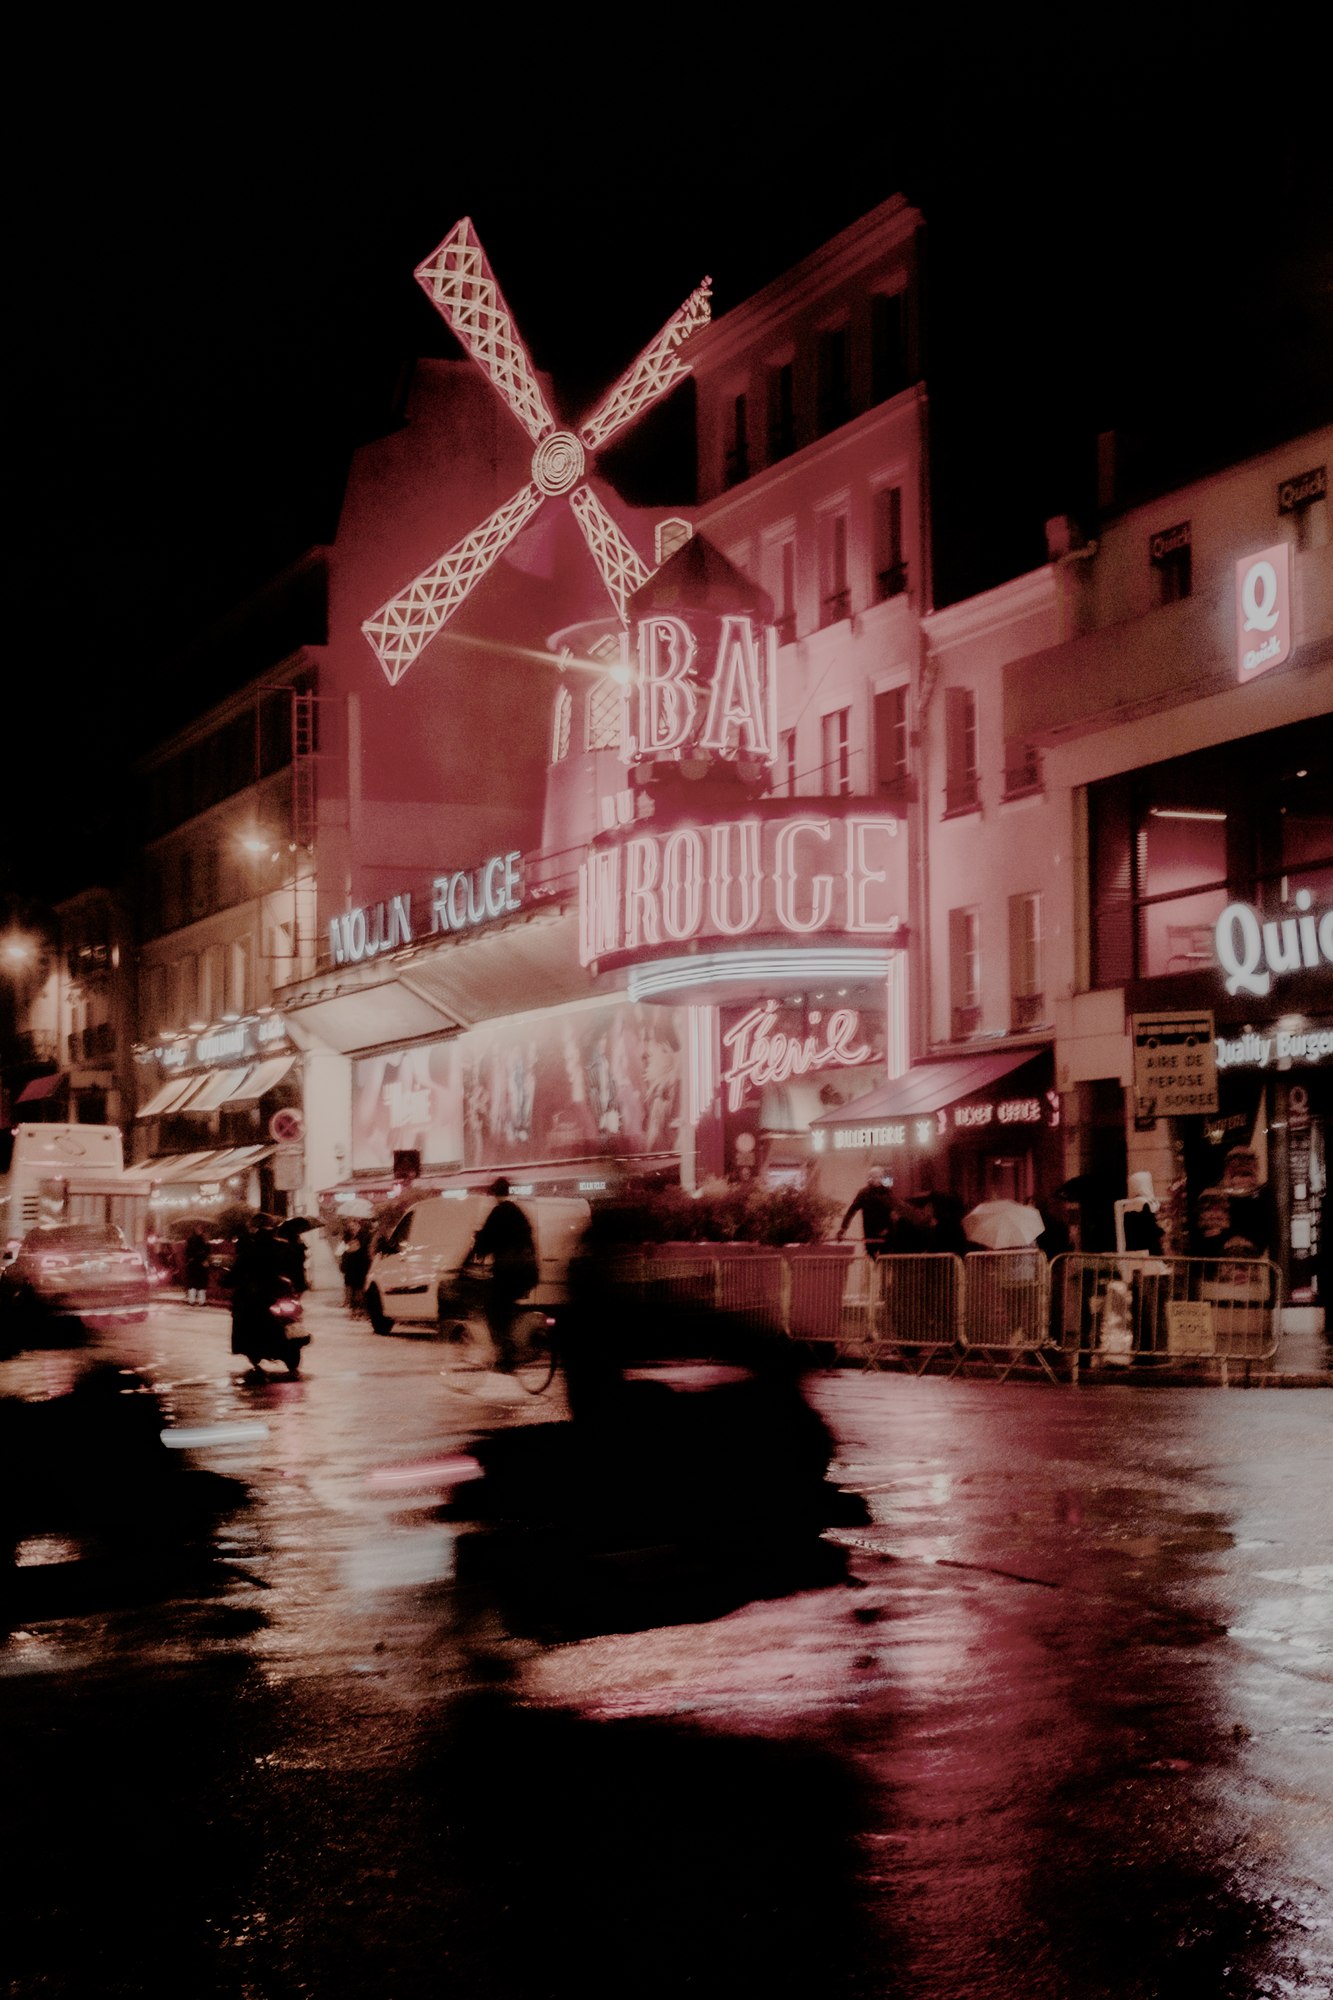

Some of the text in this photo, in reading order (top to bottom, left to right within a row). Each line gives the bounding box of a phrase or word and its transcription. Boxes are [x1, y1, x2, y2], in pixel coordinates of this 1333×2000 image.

[1241, 561, 1280, 632] Q
[1243, 634, 1281, 670] Quick
[432, 850, 522, 934] ROUGE
[626, 818, 900, 949] ROUGE
[1184, 1054, 1205, 1067] DE
[1277, 1031, 1333, 1061] Burge
